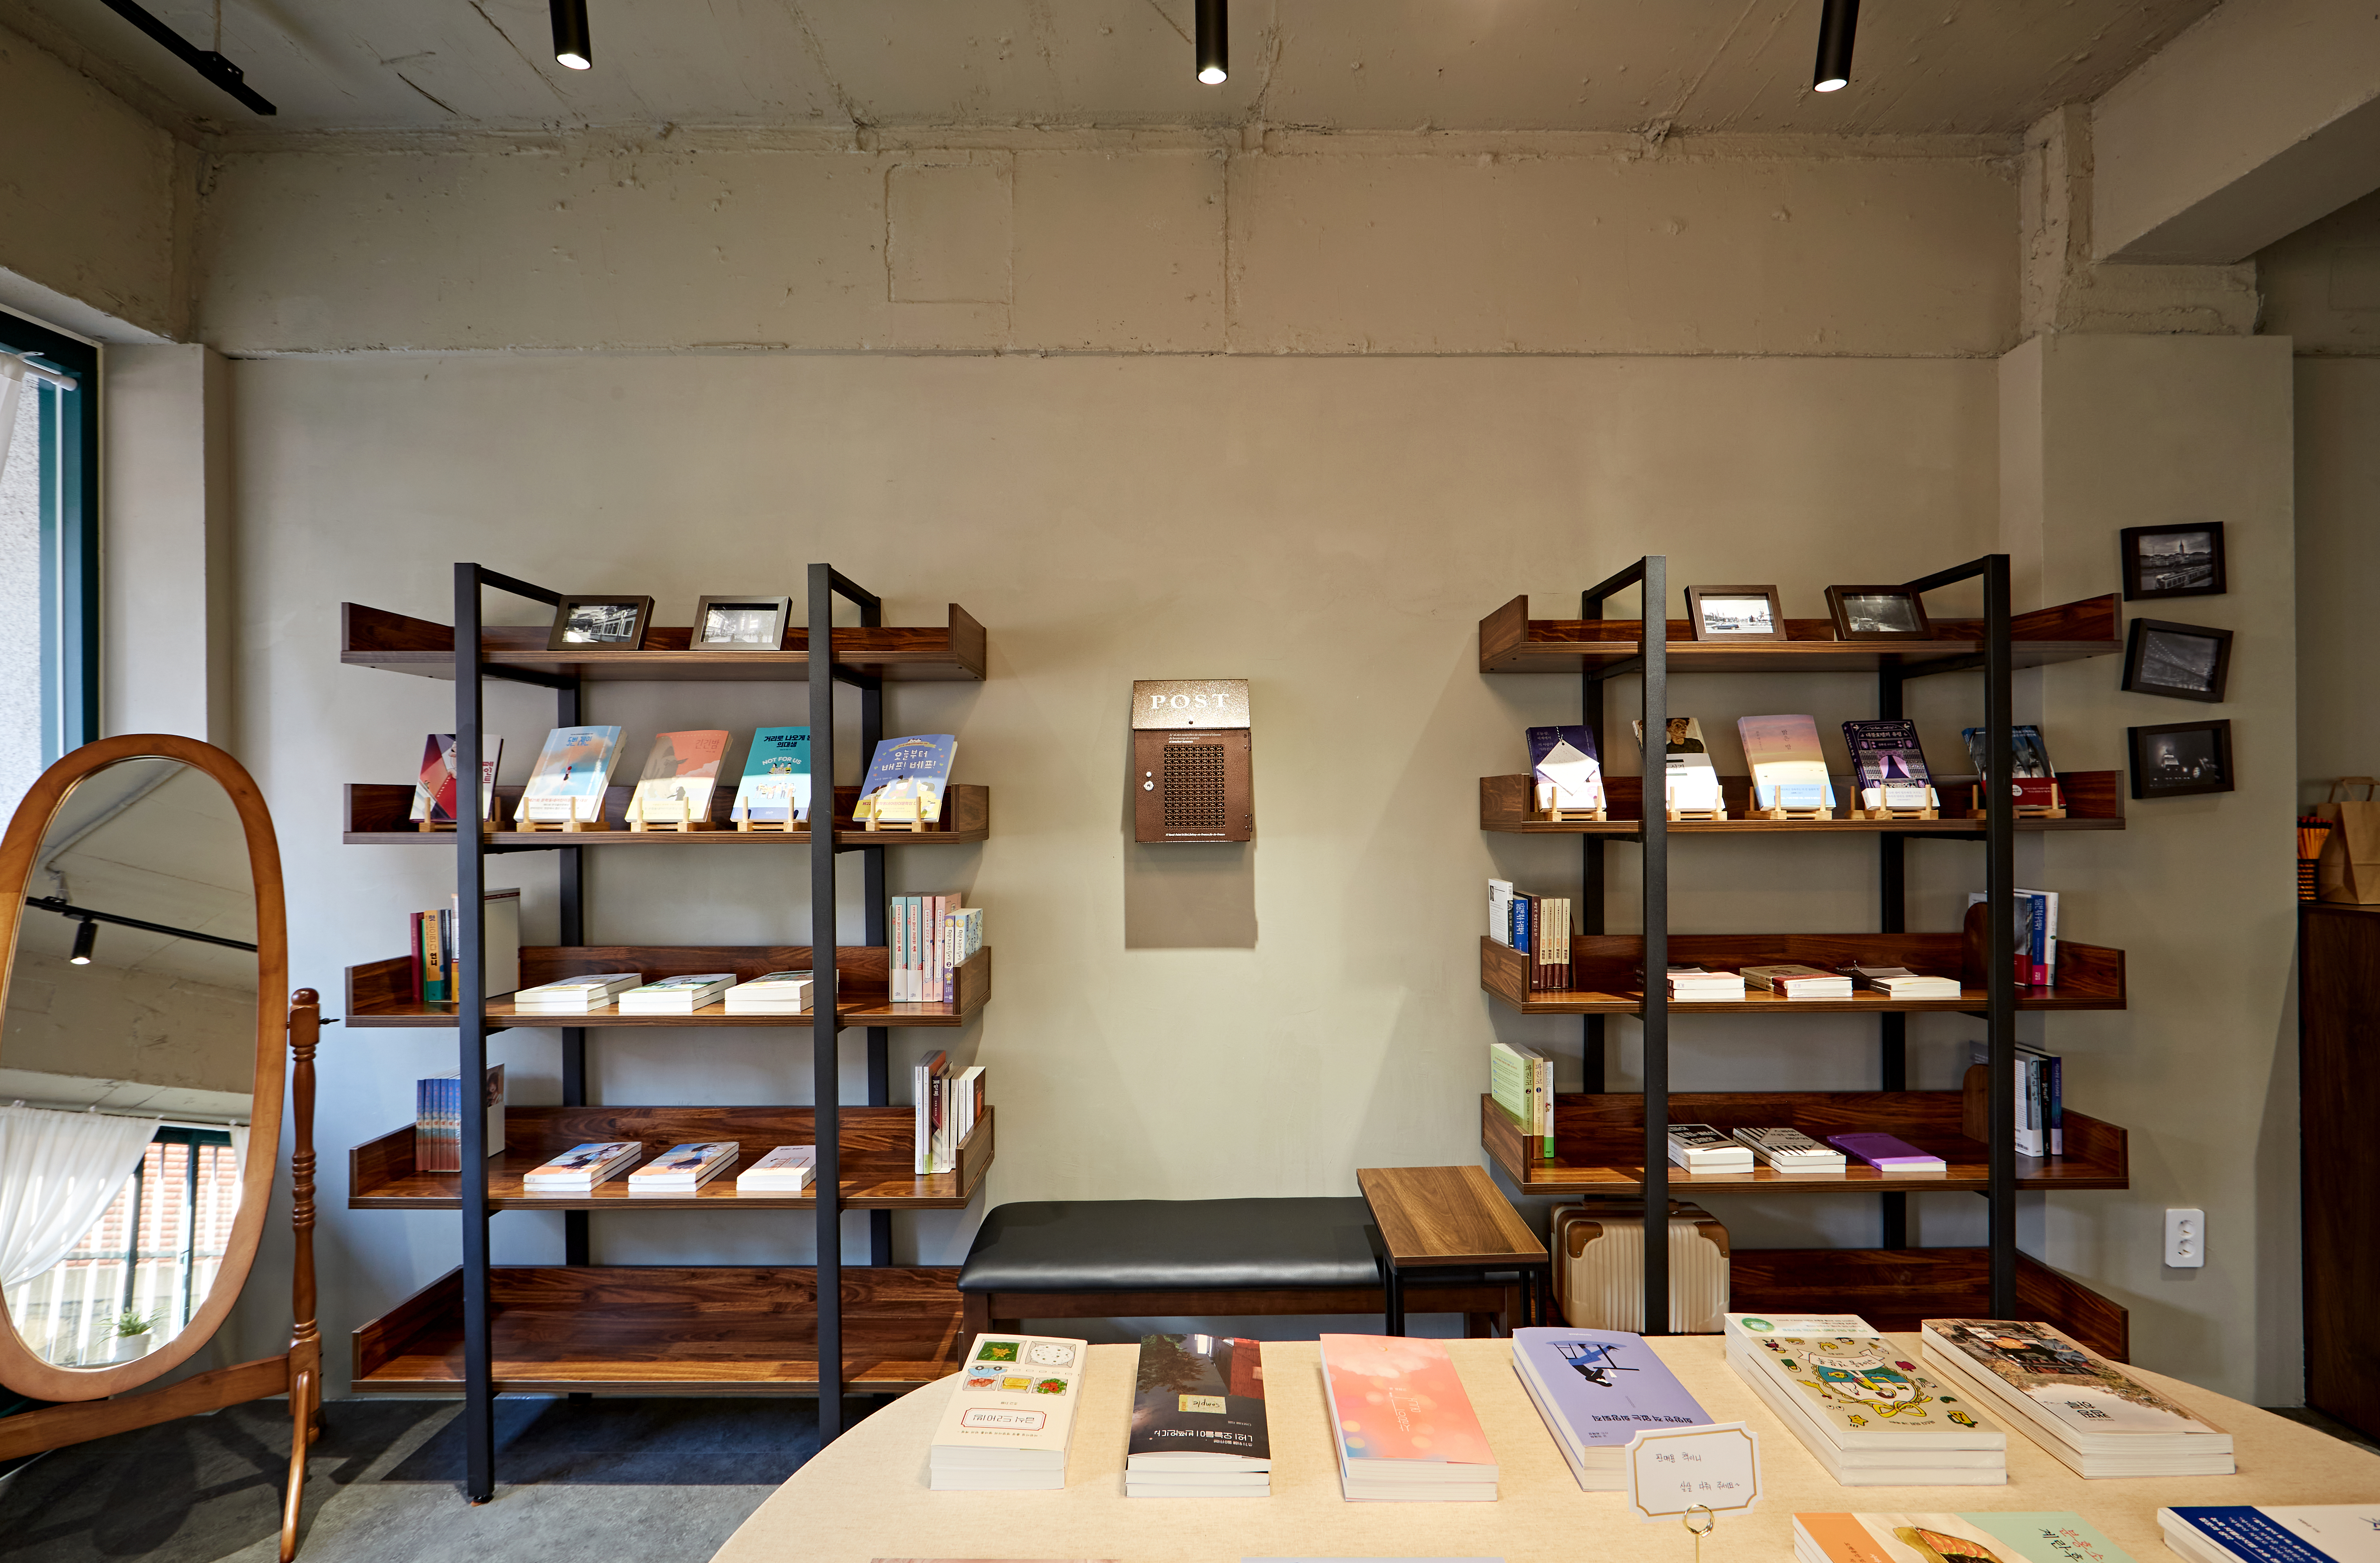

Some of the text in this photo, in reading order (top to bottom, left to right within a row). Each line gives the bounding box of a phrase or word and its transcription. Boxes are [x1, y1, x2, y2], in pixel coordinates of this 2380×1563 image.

[1150, 694, 1229, 709] POST
[567, 737, 578, 746] 5번
[696, 739, 719, 749] 긴긴밤
[894, 749, 928, 760] 오늘부터
[882, 761, 936, 771] 배프! 베프!
[1516, 903, 1525, 914] 달콤한
[1851, 1358, 1878, 1367] 귀여움
[1193, 1399, 1220, 1408] sample
[1663, 1416, 1693, 1424] 희망한
[1196, 1430, 1232, 1439] 오늘들이
[1235, 1433, 1253, 1442] 나의
[1656, 1452, 1701, 1463] 판매용 책이니
[1680, 1481, 1692, 1492] 살살
[2039, 1528, 2086, 1563] 계란후
[2059, 1527, 2104, 1563] 분홍소
